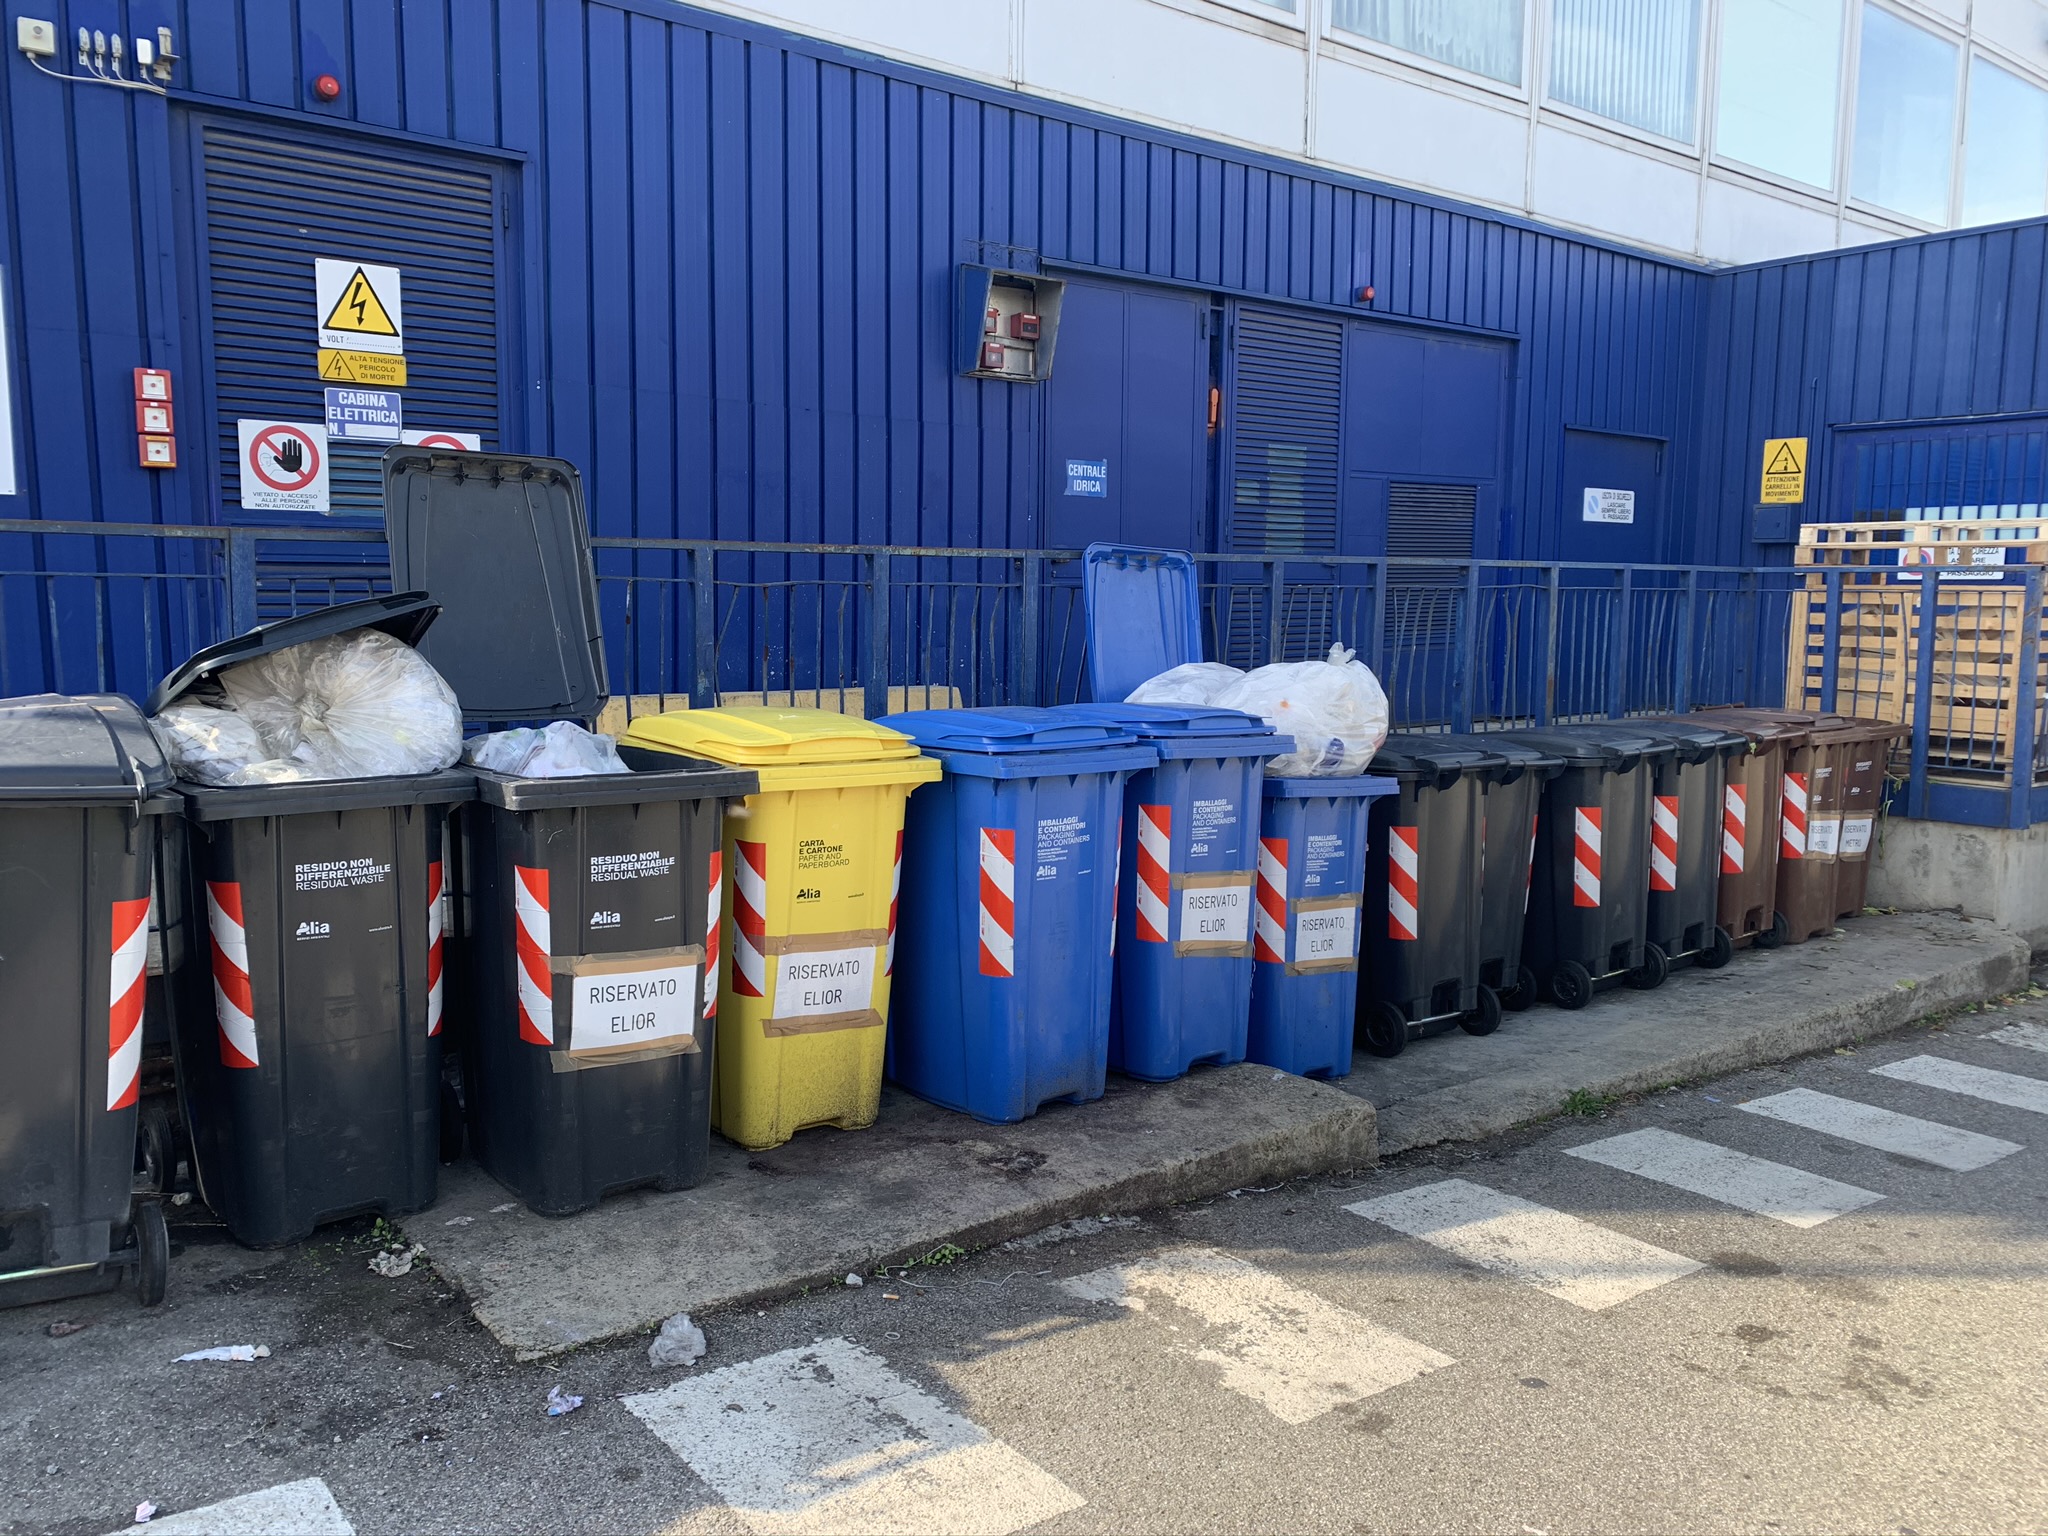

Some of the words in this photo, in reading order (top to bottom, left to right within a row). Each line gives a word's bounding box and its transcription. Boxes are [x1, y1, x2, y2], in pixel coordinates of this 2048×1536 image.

[326, 334, 344, 343] VOLT
[369, 356, 404, 365] TENSIONE
[359, 364, 396, 373] PERICOLO
[338, 392, 388, 407] CABINA
[328, 407, 398, 424] ELETTRICA
[329, 422, 342, 435] N.
[1068, 464, 1106, 478] CENTRALE
[1074, 480, 1100, 492] IDRICA
[1038, 816, 1078, 826] IMBALLAGGI
[1044, 822, 1086, 833] CONTENITORI
[1038, 831, 1075, 841] PACKAGING
[1053, 834, 1090, 846] CONTAINERS
[806, 845, 843, 854] CARTONE
[1191, 843, 1208, 853] Alia
[591, 854, 637, 865] RESIDUO
[640, 851, 659, 860] NON
[799, 854, 824, 862] PAPER
[826, 852, 841, 860] AND
[295, 861, 347, 873] RESIDUO
[350, 858, 373, 868] NON
[591, 857, 675, 873] DIFFERENZIABILE
[799, 859, 850, 870] PAPERBOARD
[1036, 865, 1056, 877] Alia
[295, 864, 391, 881] DIFFERENZIABILE
[591, 871, 638, 882] RESIDUAL
[640, 866, 669, 877] WASTE
[1305, 874, 1320, 883] Alia
[296, 879, 348, 891] RESIDUAL
[351, 874, 384, 885] WASTE
[797, 888, 821, 899] Alia
[1189, 894, 1238, 909] RISERVATO
[590, 911, 620, 924] Alia
[1302, 917, 1344, 931] RISERVATO
[296, 921, 330, 936] Alia
[1200, 919, 1225, 932] ELIOR
[1311, 939, 1334, 952] ELIOR
[789, 960, 860, 980] RISERVATO
[590, 979, 677, 1004] RISERVATO
[804, 989, 842, 1006] ELIOR
[612, 1012, 655, 1033] ELIOR
